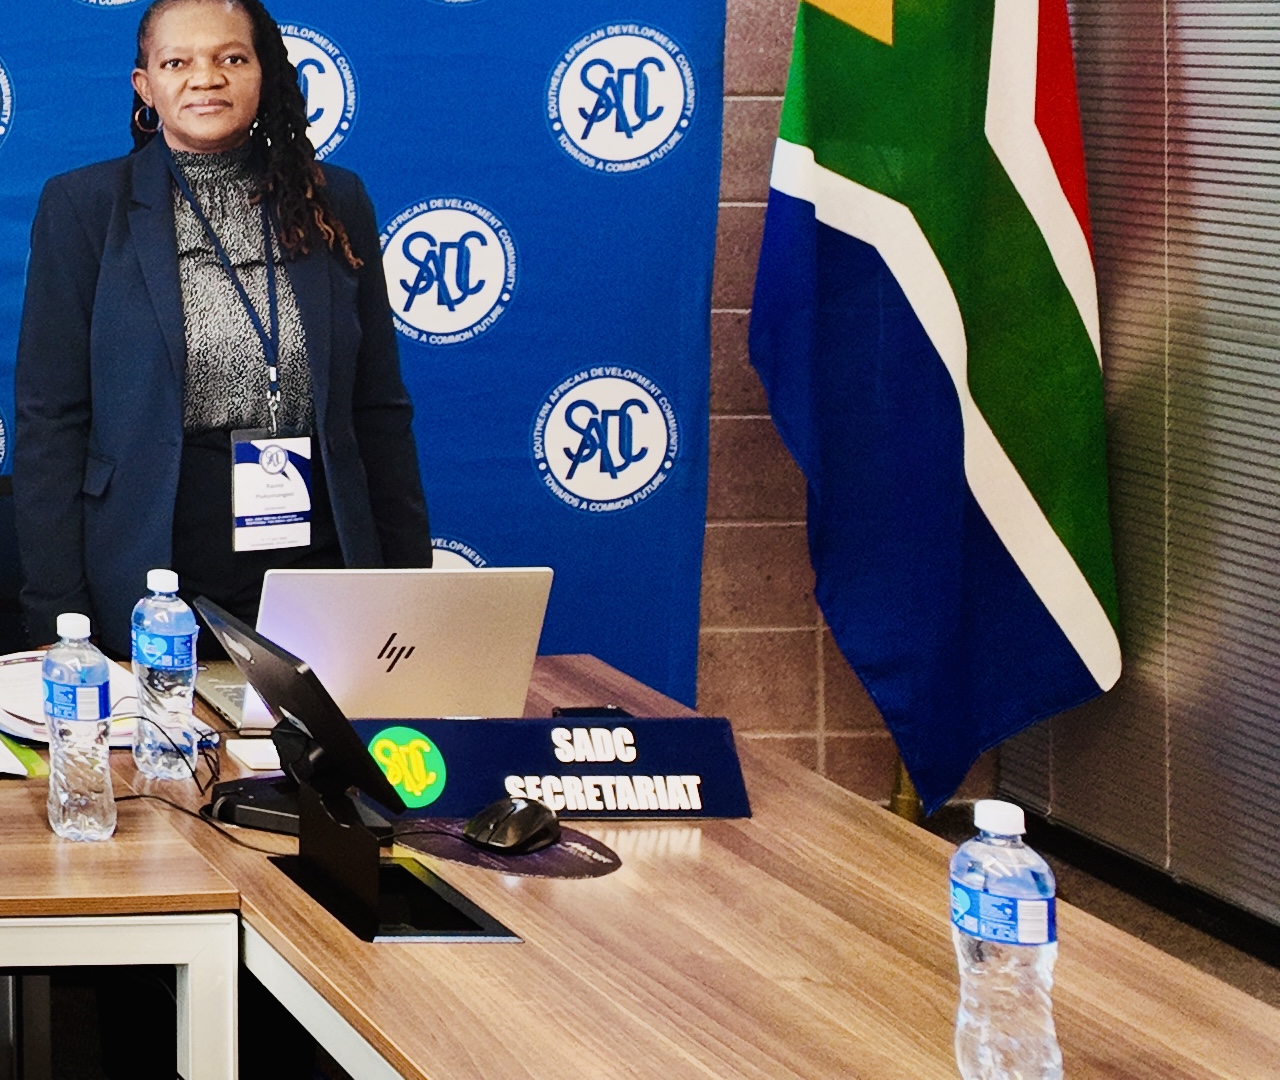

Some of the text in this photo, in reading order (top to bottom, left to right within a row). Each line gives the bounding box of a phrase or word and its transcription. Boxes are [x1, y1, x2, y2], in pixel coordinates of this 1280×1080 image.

[547, 24, 696, 119] SOUTHERN AFRICAN DEVELOPMENT COMMUNITY
[550, 727, 637, 762] SADC
[504, 775, 702, 811] SECRETARIAT
